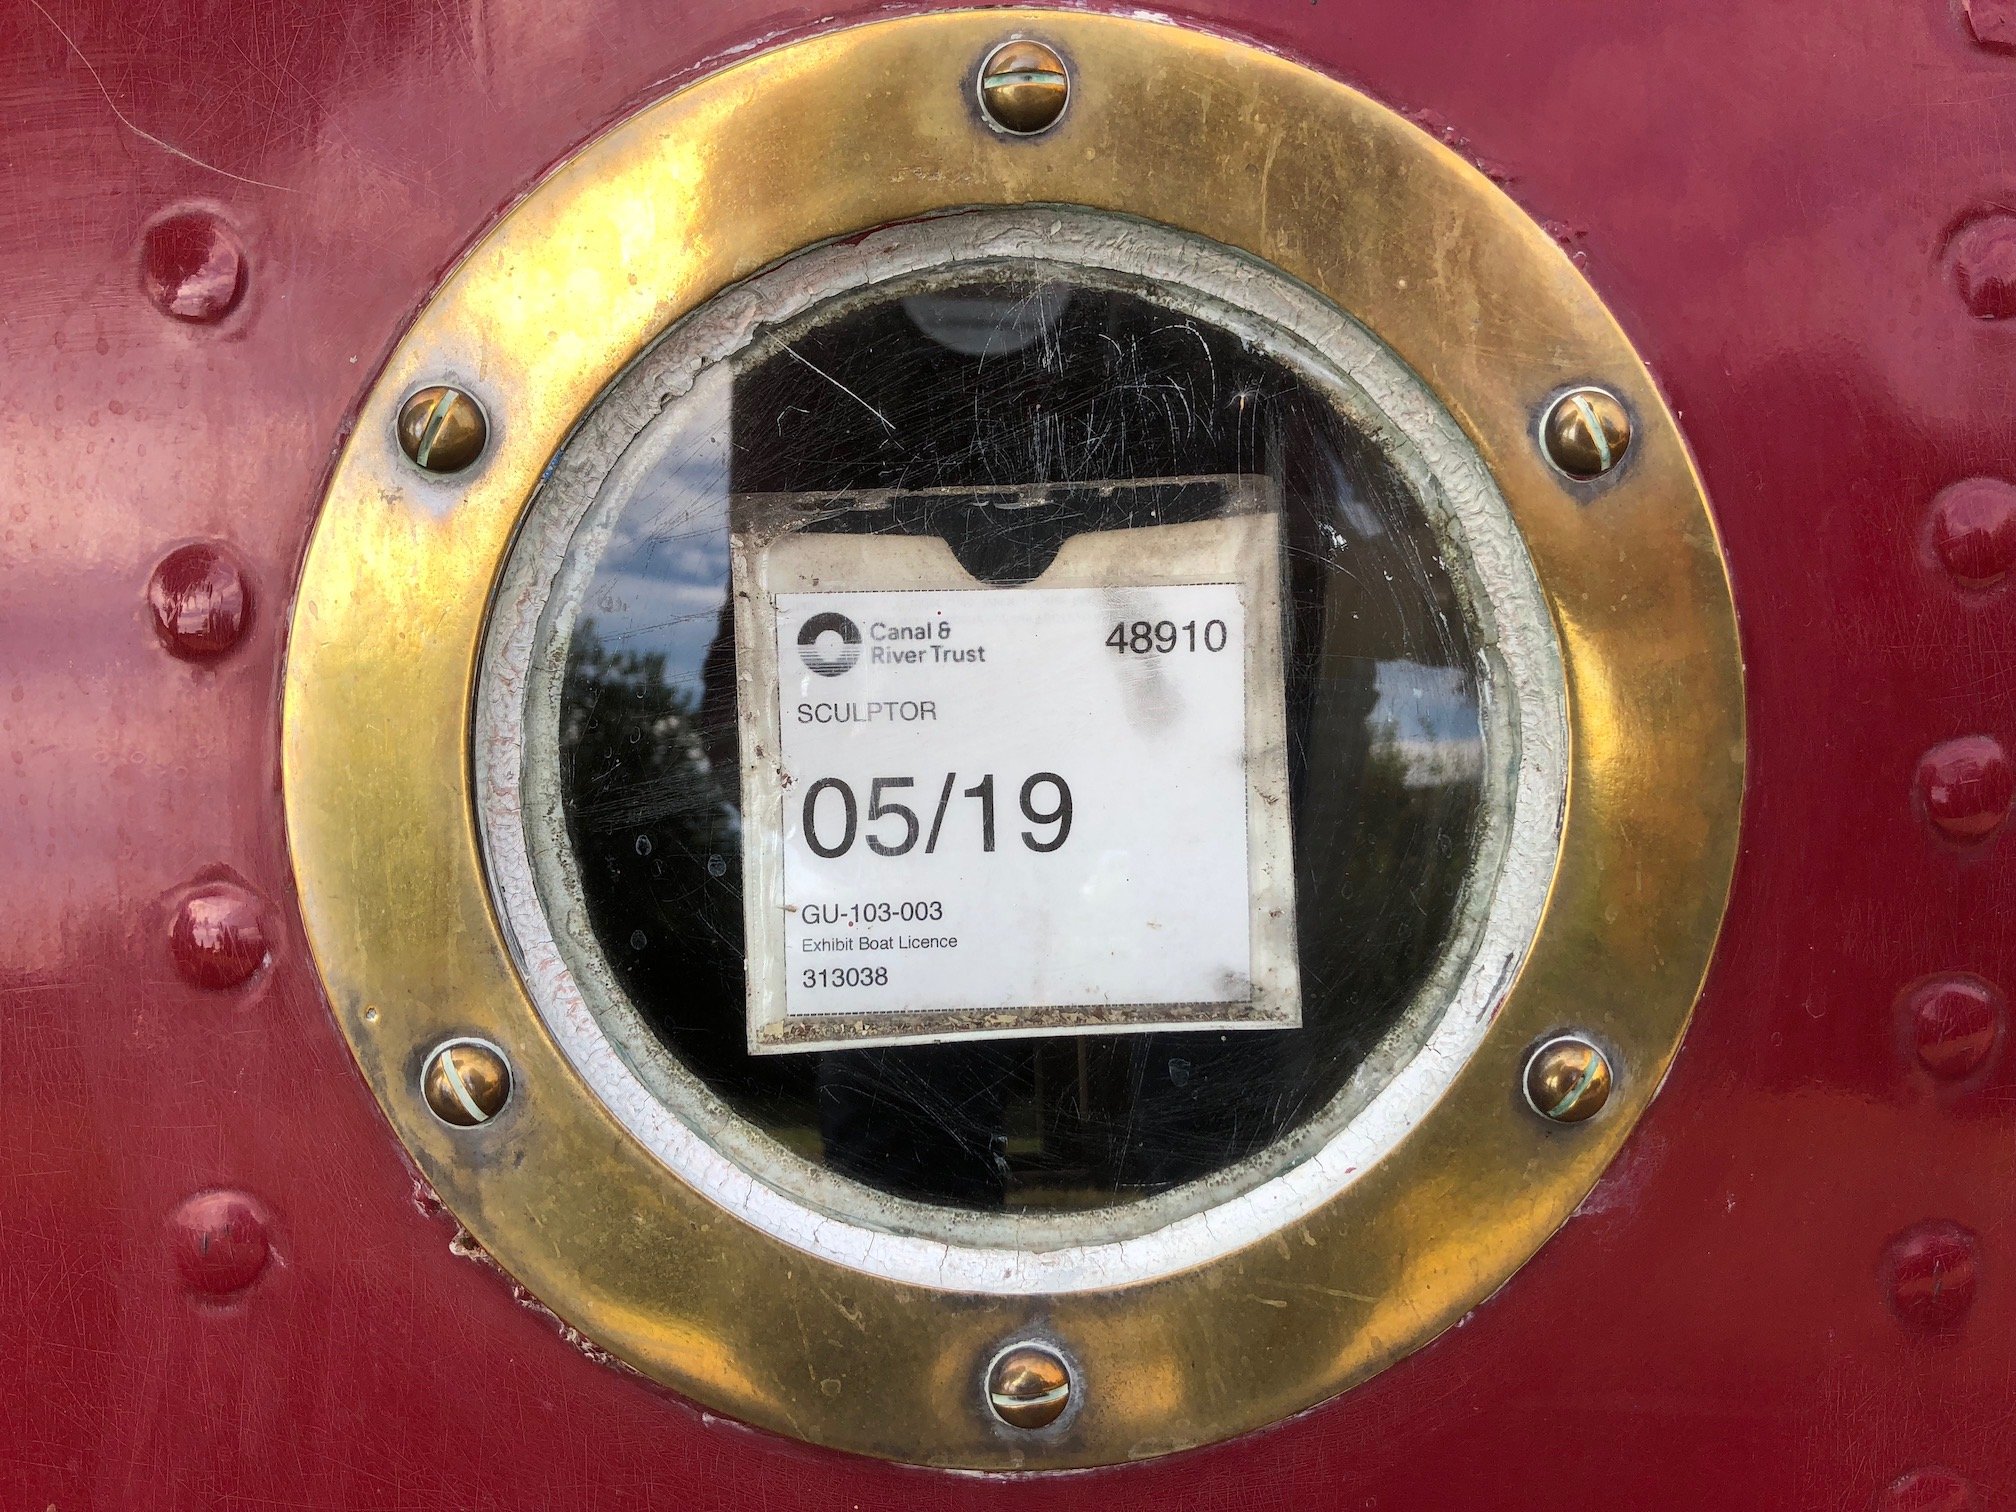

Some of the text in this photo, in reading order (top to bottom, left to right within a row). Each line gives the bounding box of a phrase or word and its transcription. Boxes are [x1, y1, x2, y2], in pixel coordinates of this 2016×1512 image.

[870, 621, 951, 641] Canal &
[1105, 619, 1228, 654] 48910
[871, 644, 986, 665] River Trust
[797, 701, 938, 724] SCULPTOR
[802, 771, 1074, 859] 05/19
[801, 901, 944, 924] GU-103-003
[802, 935, 958, 952] Exhibit Boat Licence
[802, 966, 889, 989] 313038
